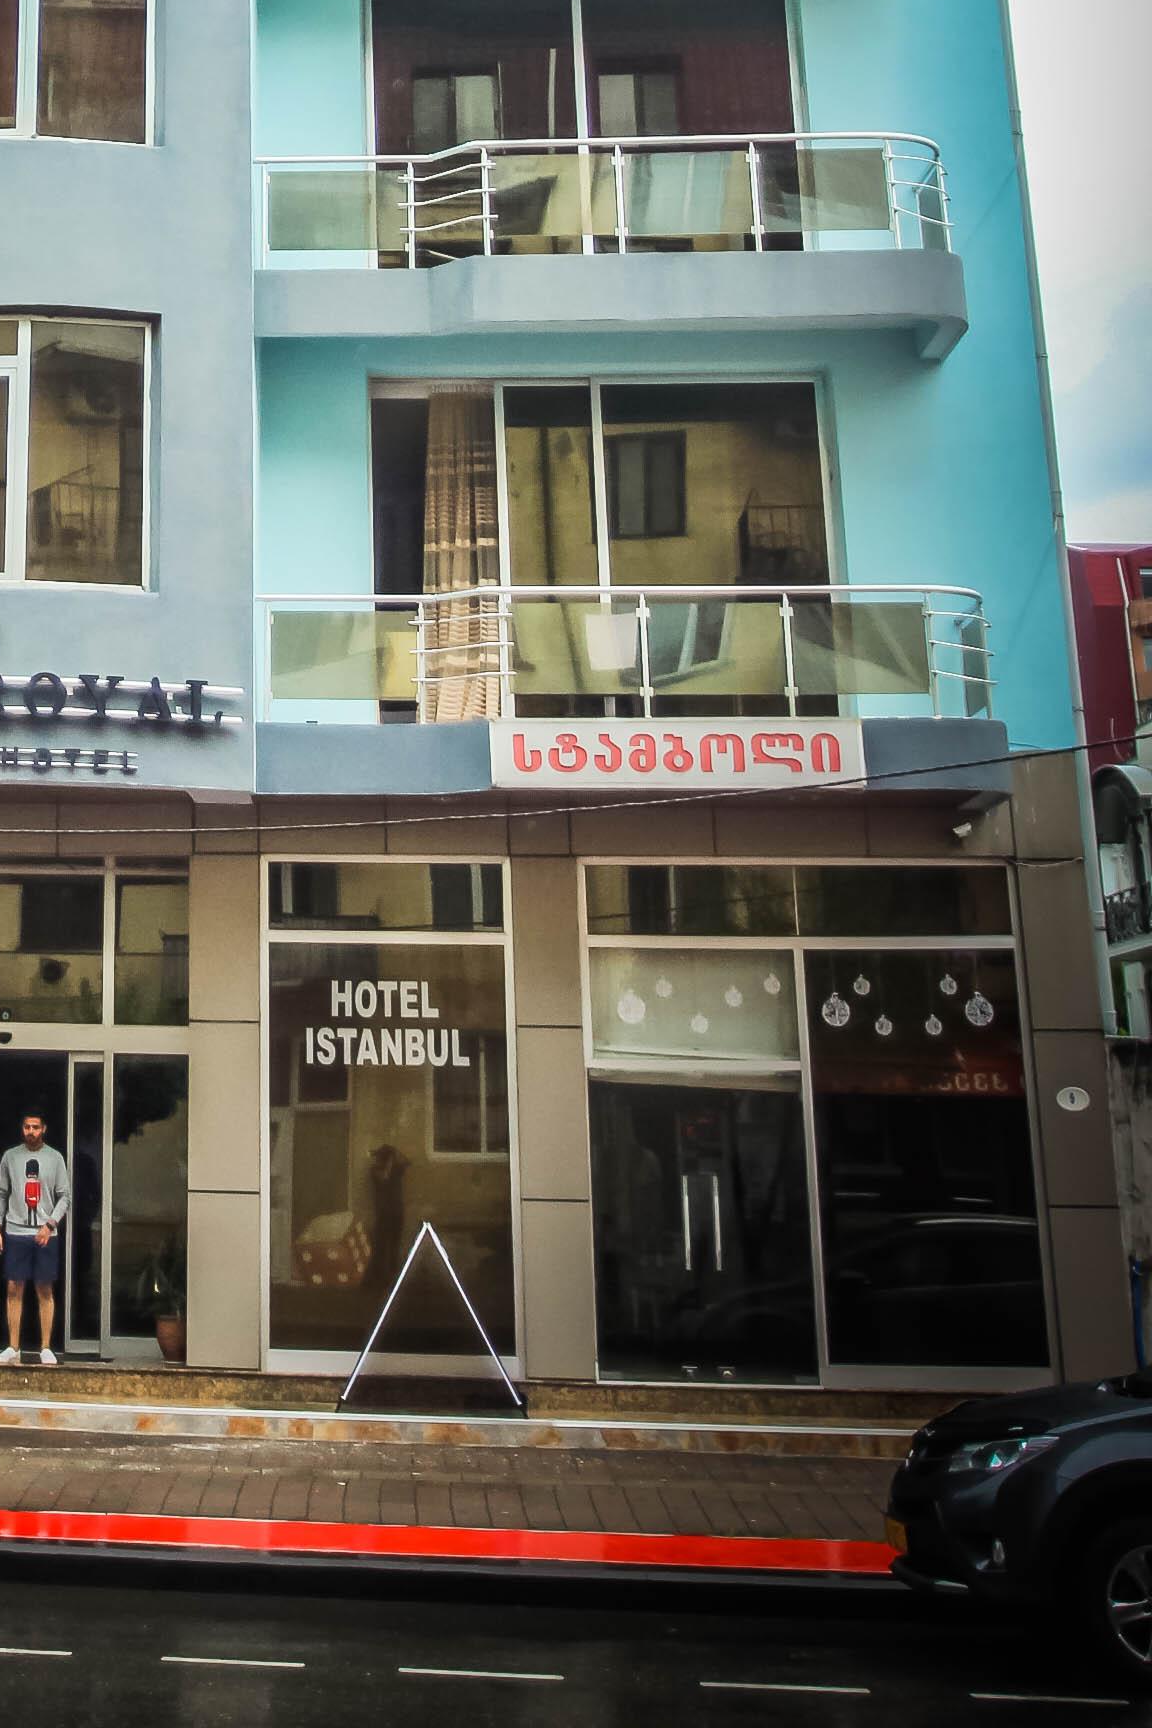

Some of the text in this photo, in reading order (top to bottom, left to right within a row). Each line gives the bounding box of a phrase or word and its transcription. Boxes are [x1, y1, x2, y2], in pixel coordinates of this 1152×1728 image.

[1, 745, 138, 774] HOTEL
[512, 732, 842, 772] სტამბოლი
[331, 979, 440, 1018] HOTEL
[305, 1027, 470, 1067] ISTANBUL
